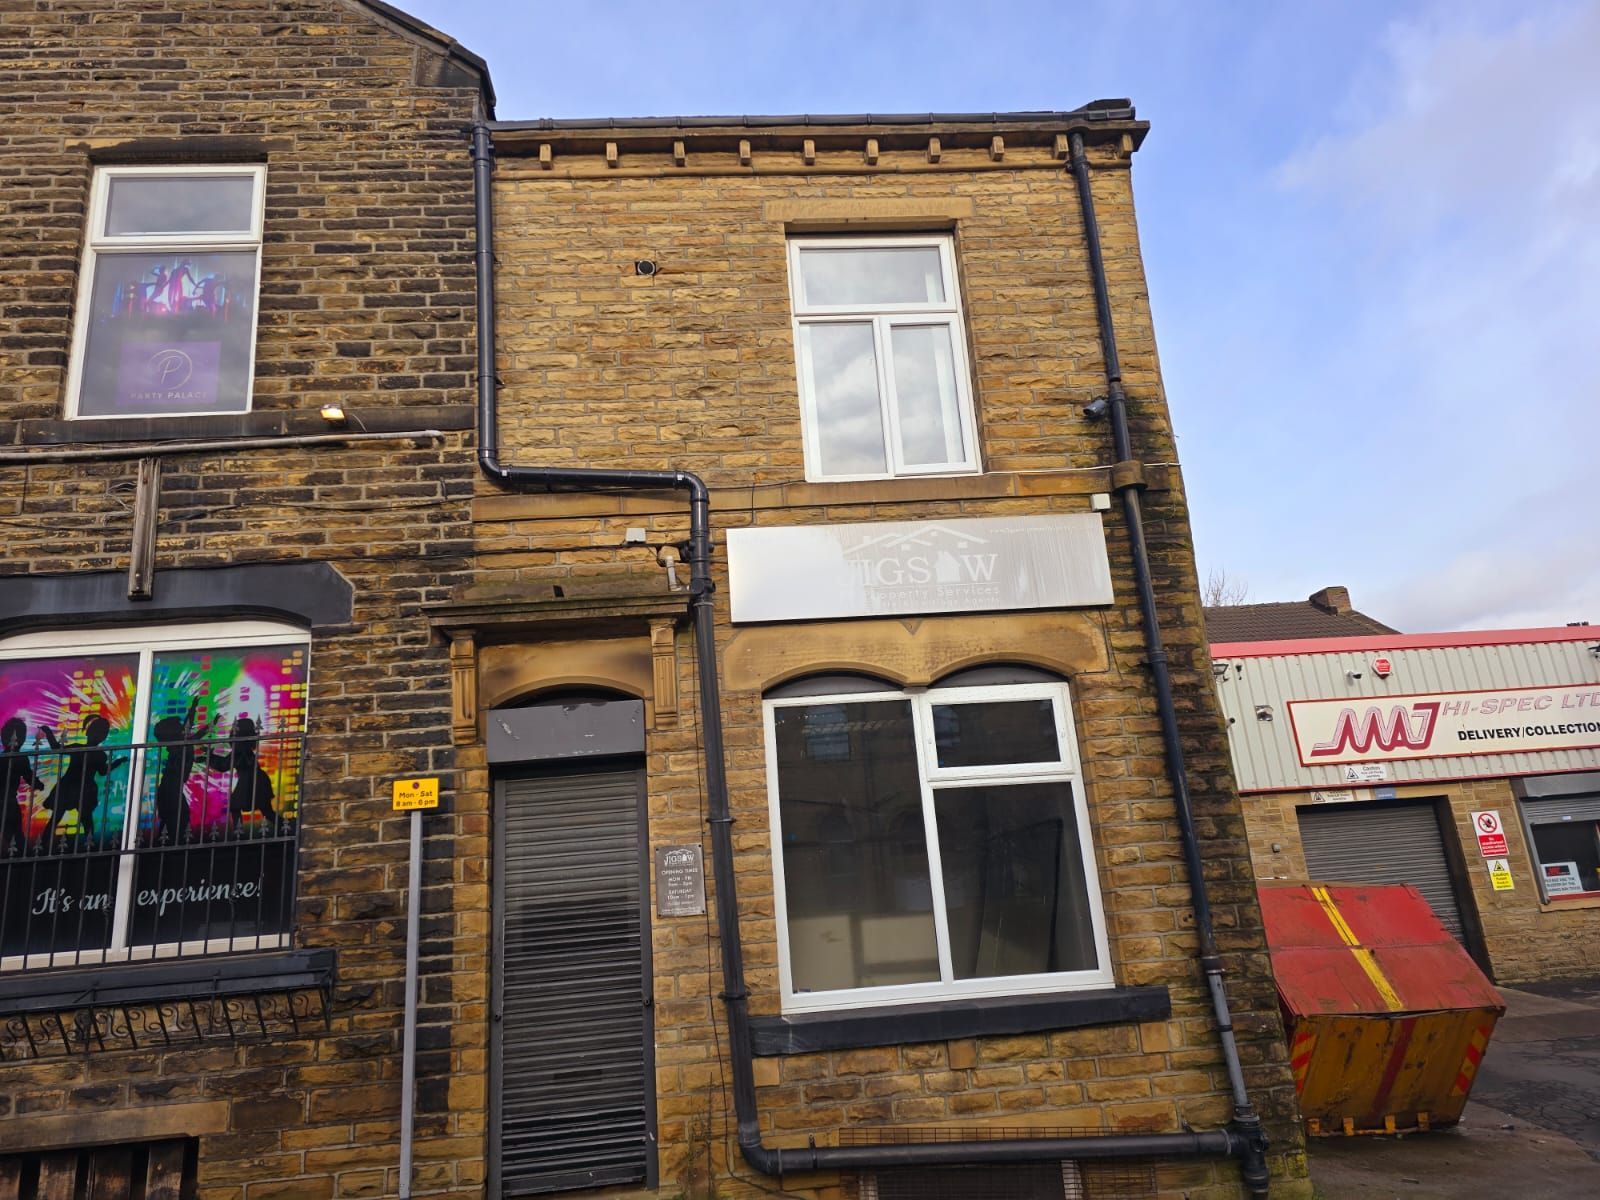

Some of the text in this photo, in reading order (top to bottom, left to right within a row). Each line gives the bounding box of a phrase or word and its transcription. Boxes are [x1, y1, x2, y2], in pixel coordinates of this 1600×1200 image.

[130, 391, 208, 400] PARTY PALACE
[936, 586, 1000, 598] Services
[1442, 695, 1553, 716] HI-SPEC
[32, 873, 264, 917] It's an experience!
